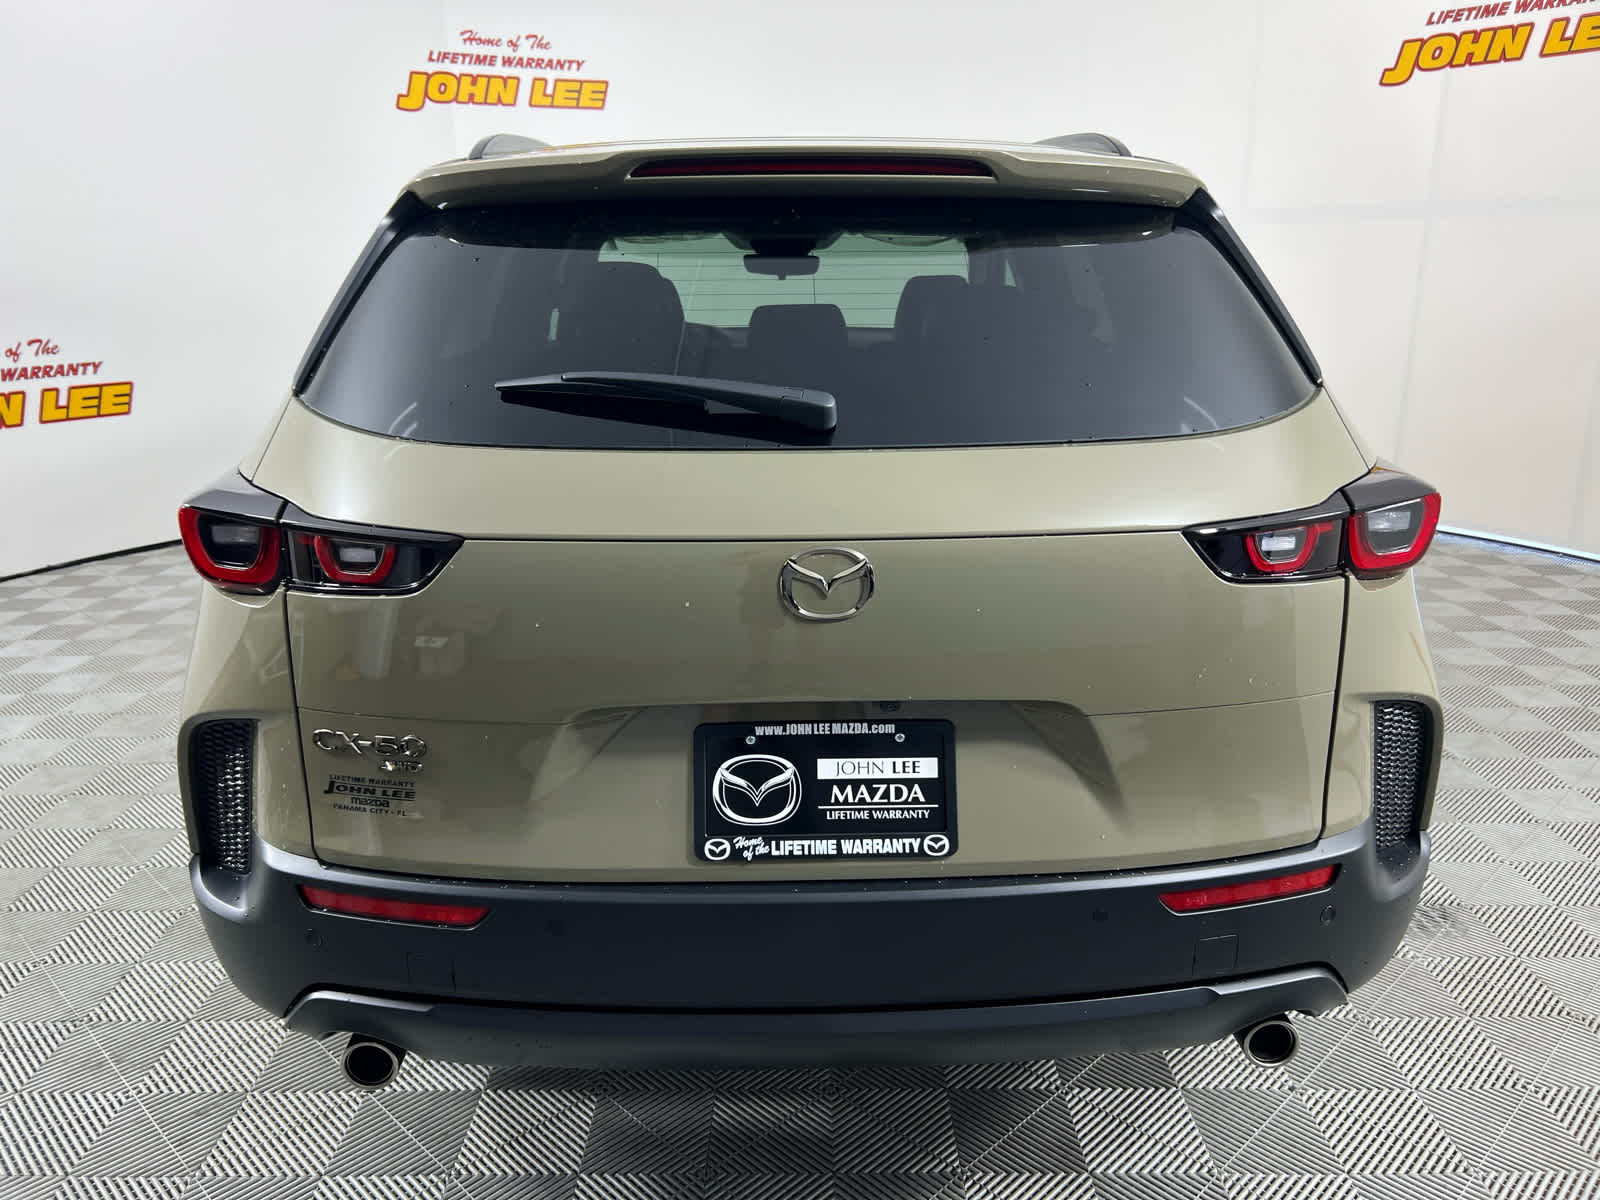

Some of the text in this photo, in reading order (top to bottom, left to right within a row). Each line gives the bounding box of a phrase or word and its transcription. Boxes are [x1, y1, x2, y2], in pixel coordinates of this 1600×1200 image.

[1425, 1, 1510, 26] LIFETIME
[460, 29, 553, 52] Home of The
[427, 50, 586, 71] LIFETIME WARRANTY
[1379, 22, 1535, 87] JOHN
[396, 70, 609, 111] JOHN LEE
[4, 339, 60, 363] of The
[0, 361, 103, 382] WARRANTY
[39, 381, 134, 424] LEE
[312, 728, 427, 758] CX-50
[835, 760, 921, 777] JOHN LEE
[324, 780, 417, 799] JOHN LEE
[830, 783, 926, 804] MAZDA
[351, 796, 390, 808] mazda
[826, 809, 930, 820] LIFETIME WARRANTY
[733, 836, 763, 849] Home
[742, 842, 770, 861] of the
[771, 837, 921, 856] LIFETIME WARRANTY
